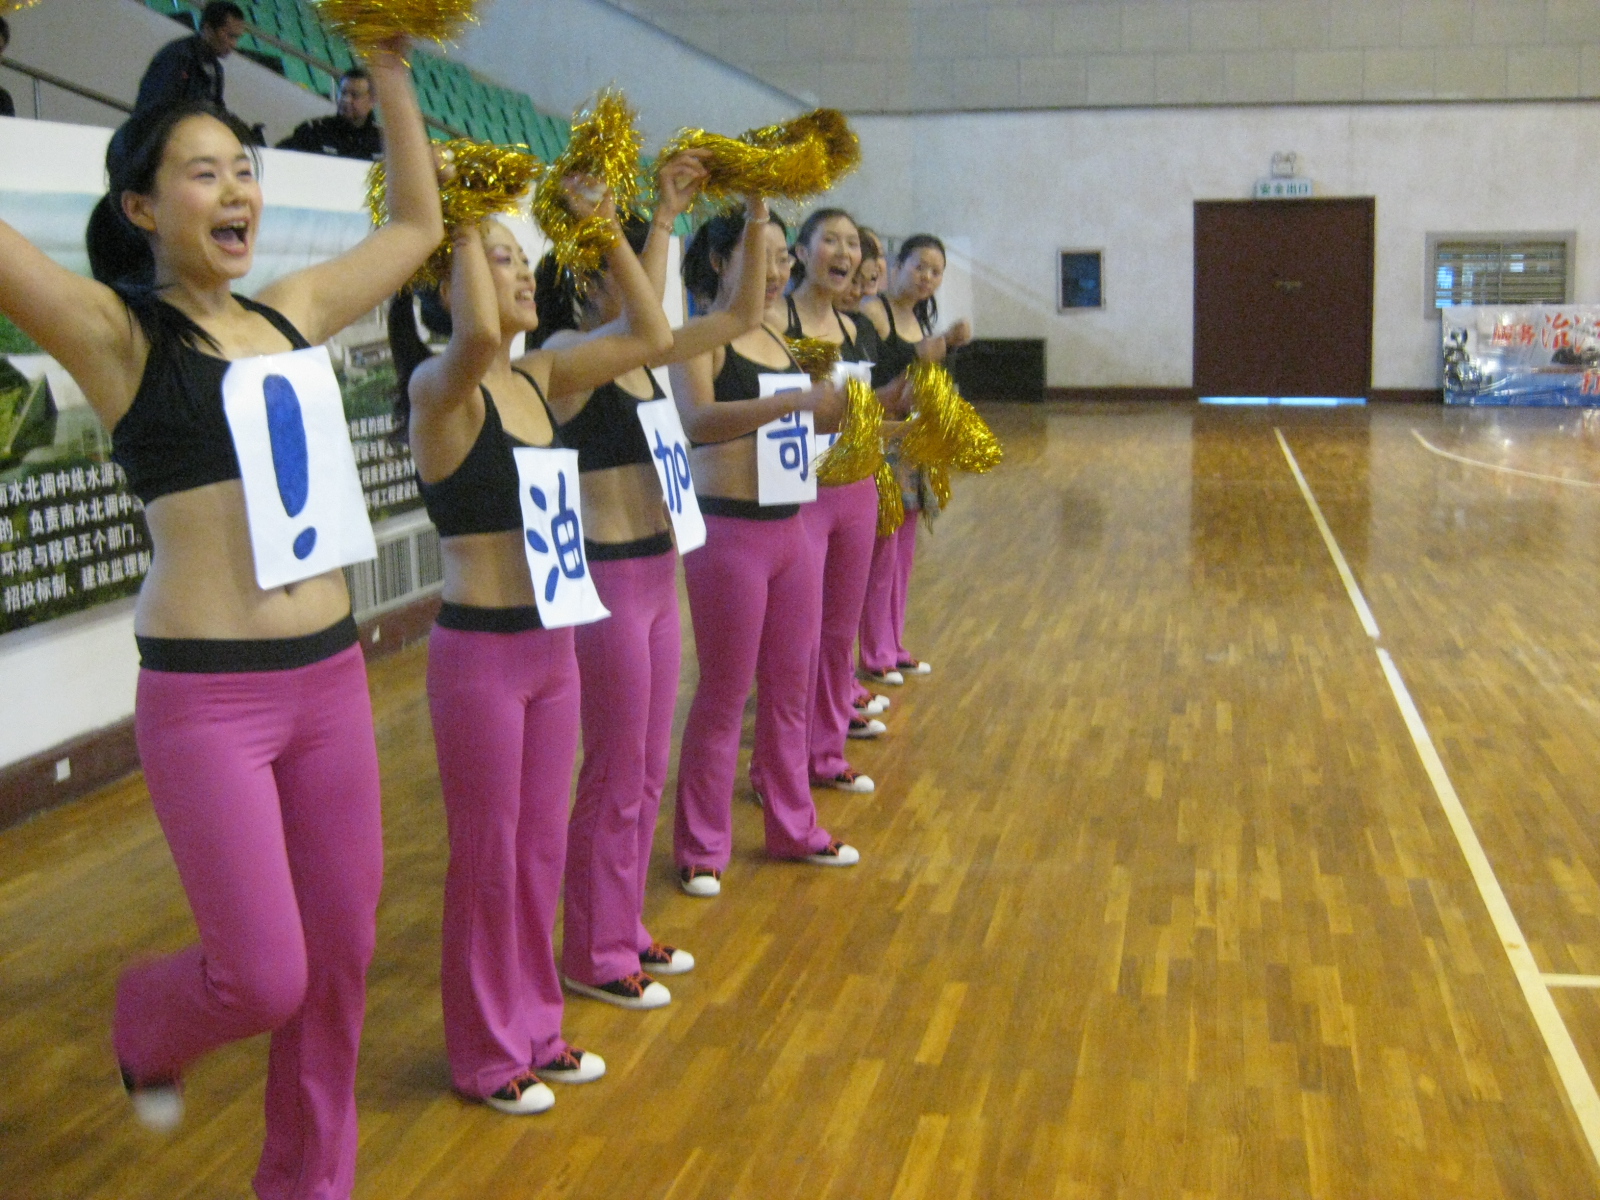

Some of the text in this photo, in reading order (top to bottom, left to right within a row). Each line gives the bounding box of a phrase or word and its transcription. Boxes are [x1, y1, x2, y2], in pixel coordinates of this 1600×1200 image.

[1260, 183, 1308, 195] 安全出口
[654, 429, 691, 514] 加
[526, 470, 585, 602] 油
